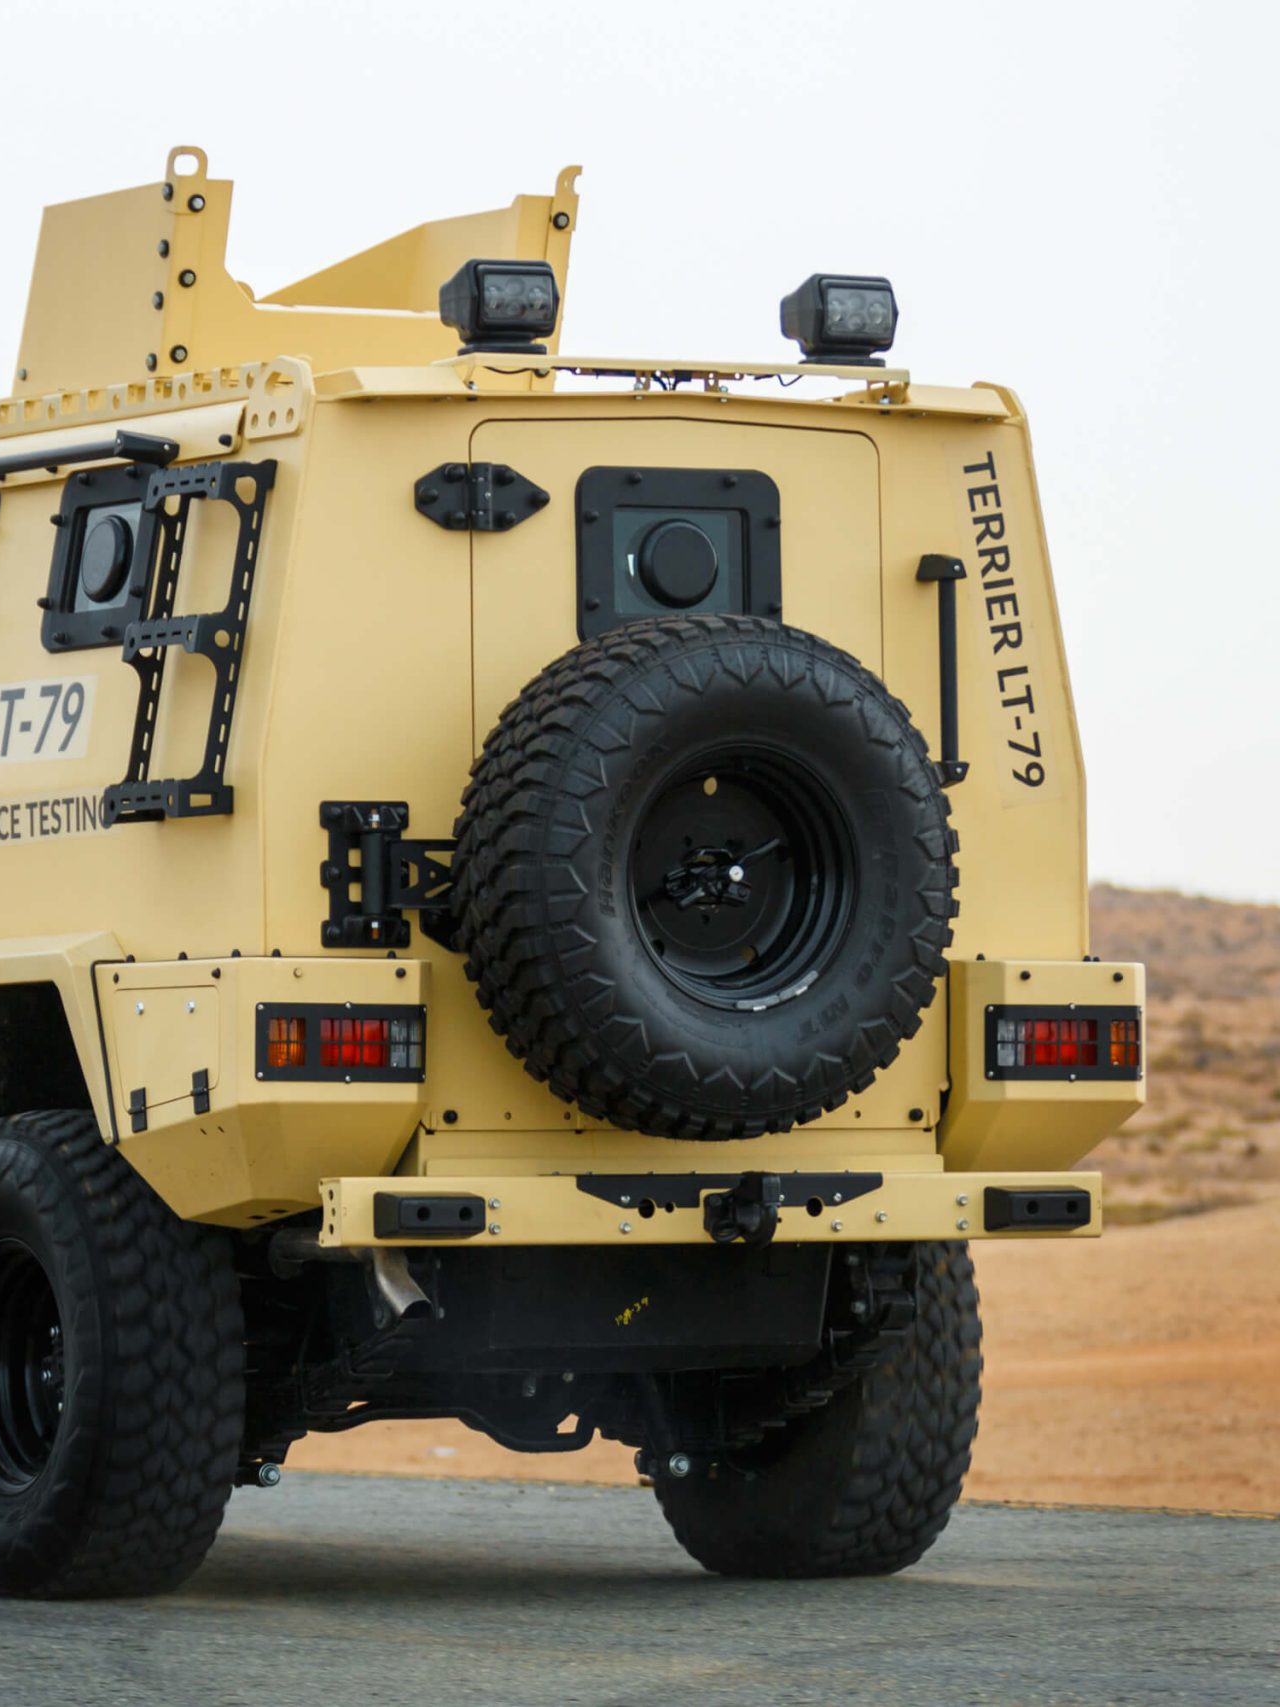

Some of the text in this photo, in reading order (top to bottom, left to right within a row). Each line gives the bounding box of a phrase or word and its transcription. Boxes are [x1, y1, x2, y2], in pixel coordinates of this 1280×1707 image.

[963, 450, 1046, 788] TERRIER LT-79
[25, 795, 106, 838] TESTIN
